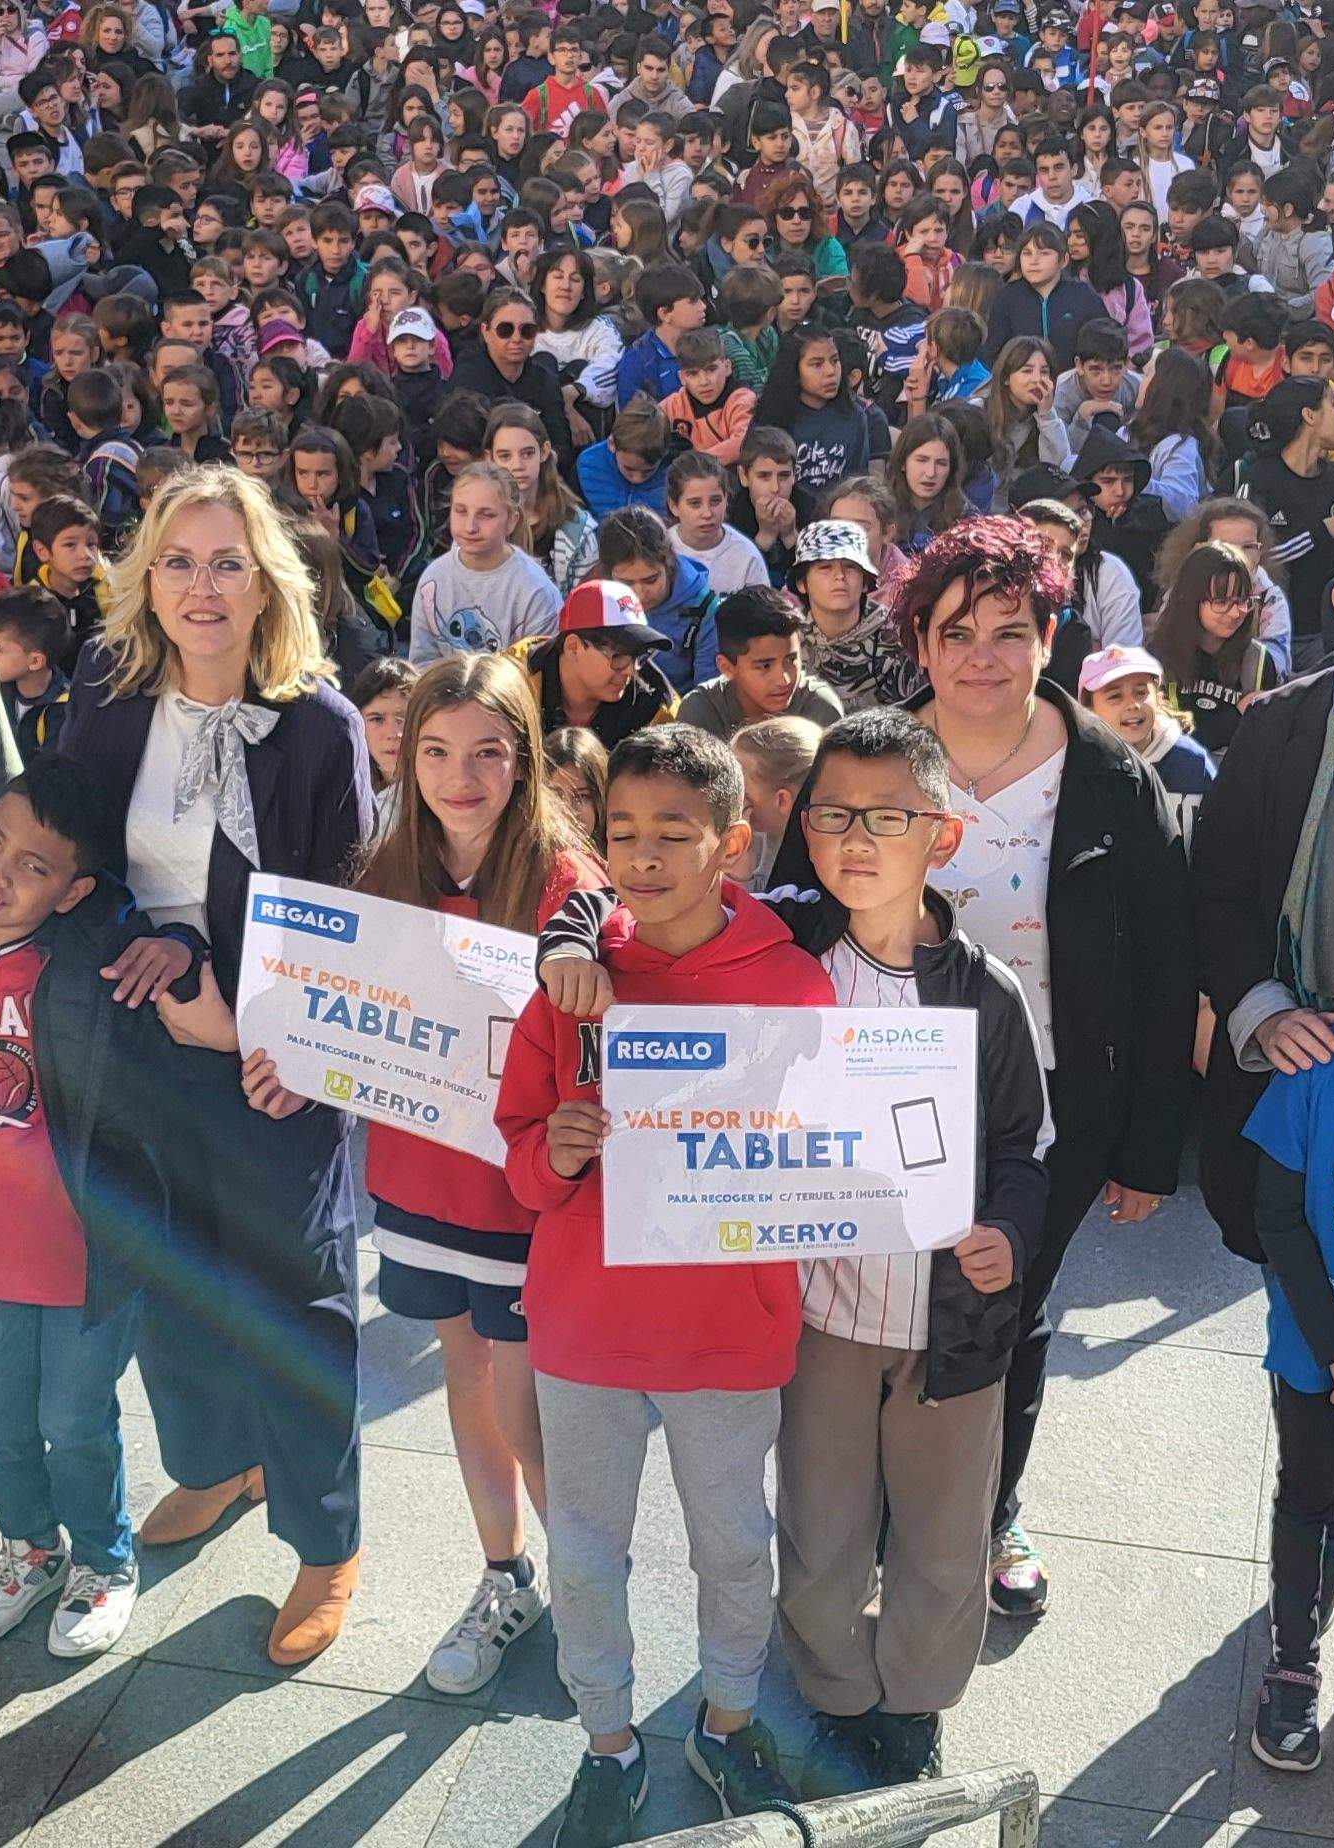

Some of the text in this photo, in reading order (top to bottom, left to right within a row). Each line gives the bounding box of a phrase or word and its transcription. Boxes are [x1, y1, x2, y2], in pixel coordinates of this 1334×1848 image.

[260, 901, 346, 933] REGALO
[261, 955, 411, 1011] VALE POR UNA
[303, 985, 460, 1059] TABLET
[857, 1028, 944, 1046] ASPACE
[286, 1033, 312, 1048] PARA
[315, 1041, 361, 1062] RECOGER
[362, 1055, 376, 1066] EN
[380, 1060, 392, 1071] C/
[394, 1064, 427, 1082] TERUEL
[617, 1041, 712, 1061] REGALO
[354, 1081, 440, 1123] XERYO
[624, 1110, 803, 1129] VALE POR UNA
[677, 1131, 862, 1170] TABLET
[667, 1188, 909, 1204] PARA RECOGER EN C/ TERUEL 28 (HUESCA)
[756, 1221, 858, 1244] XERYO
